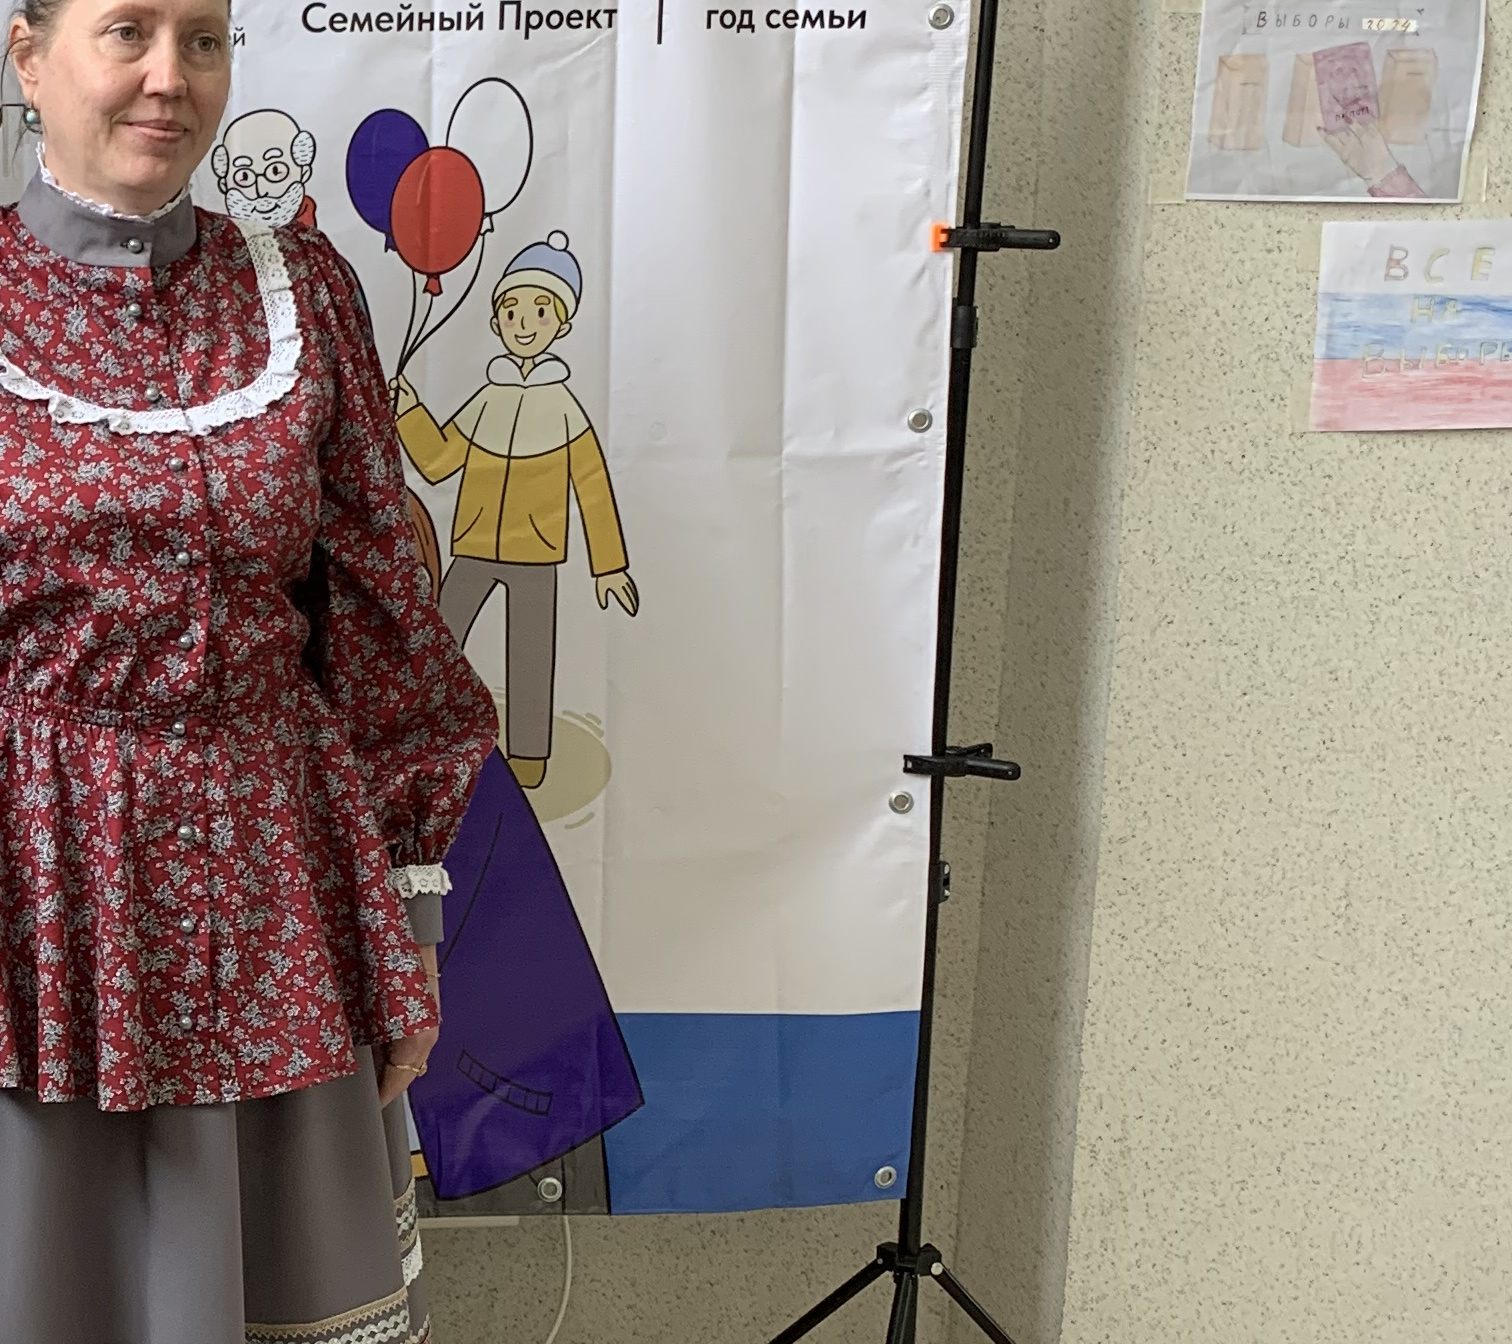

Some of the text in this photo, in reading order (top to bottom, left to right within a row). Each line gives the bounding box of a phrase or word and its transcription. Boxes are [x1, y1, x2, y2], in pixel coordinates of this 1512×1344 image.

[301, 0, 618, 40] Семейный Проект
[706, 9, 867, 34] год семьи
[1256, 11, 1412, 32] ВЫБОРЫ 2024
[1384, 244, 1496, 283] ВСЕ
